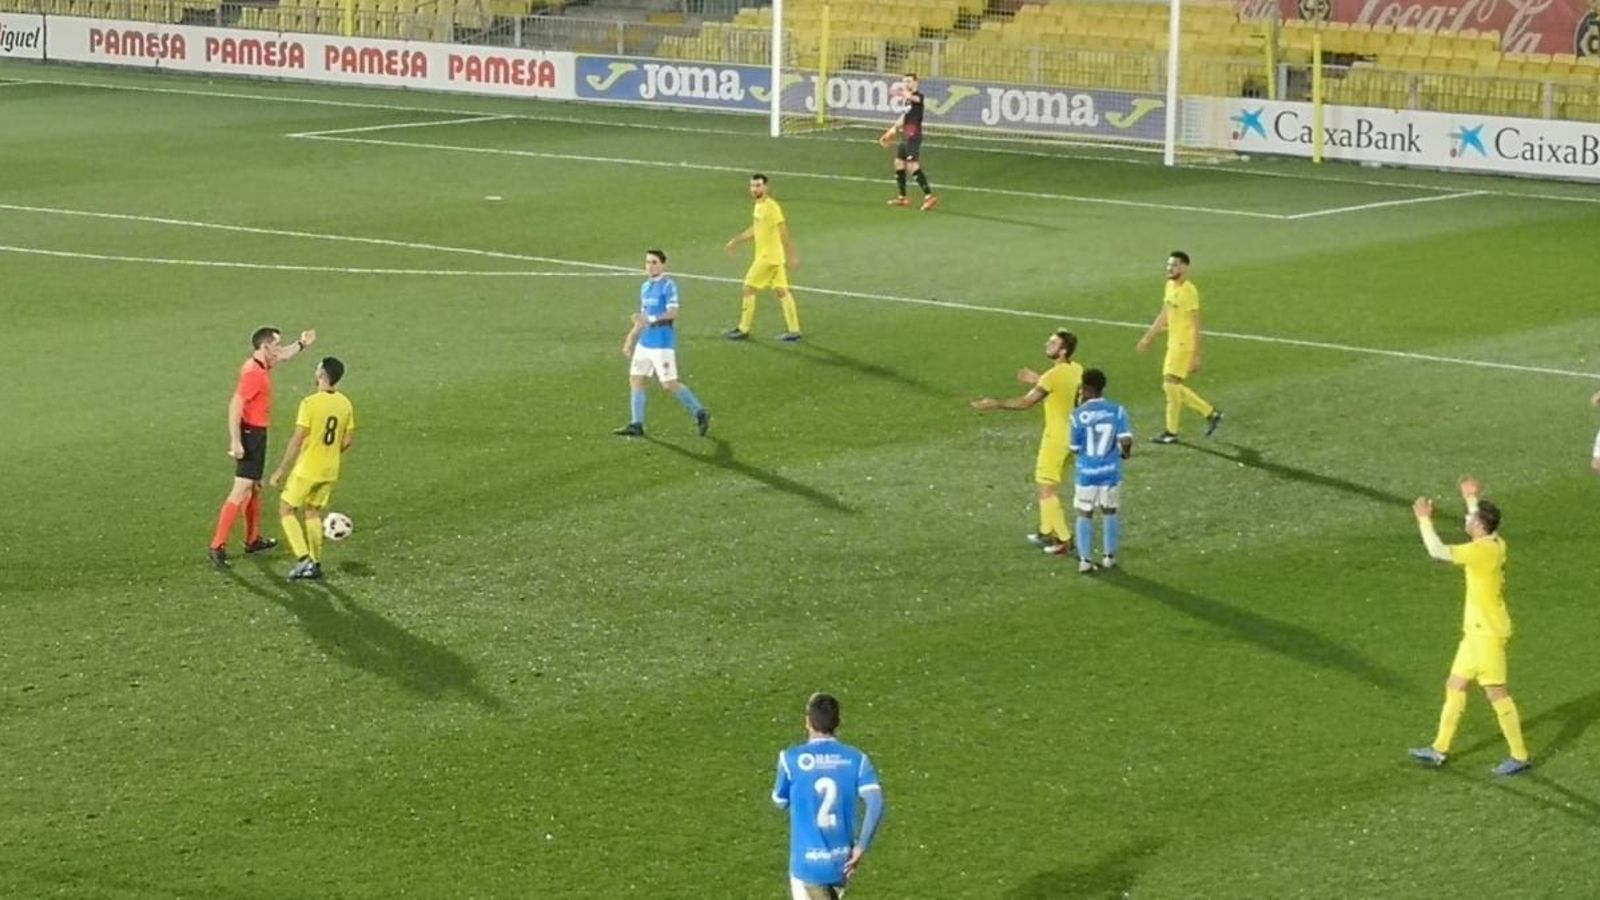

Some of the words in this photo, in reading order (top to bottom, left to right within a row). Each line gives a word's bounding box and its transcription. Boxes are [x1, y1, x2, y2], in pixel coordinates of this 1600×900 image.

[0, 22, 40, 52] iguel
[89, 28, 186, 59] PAMESA
[206, 37, 305, 68] PAMESA
[324, 44, 427, 78] PAMESA
[449, 54, 555, 88] PAMESA
[1274, 111, 1422, 153] CaxaBank
[324, 416, 338, 446] 8
[1086, 423, 1113, 457] 17
[814, 776, 837, 828] 2
